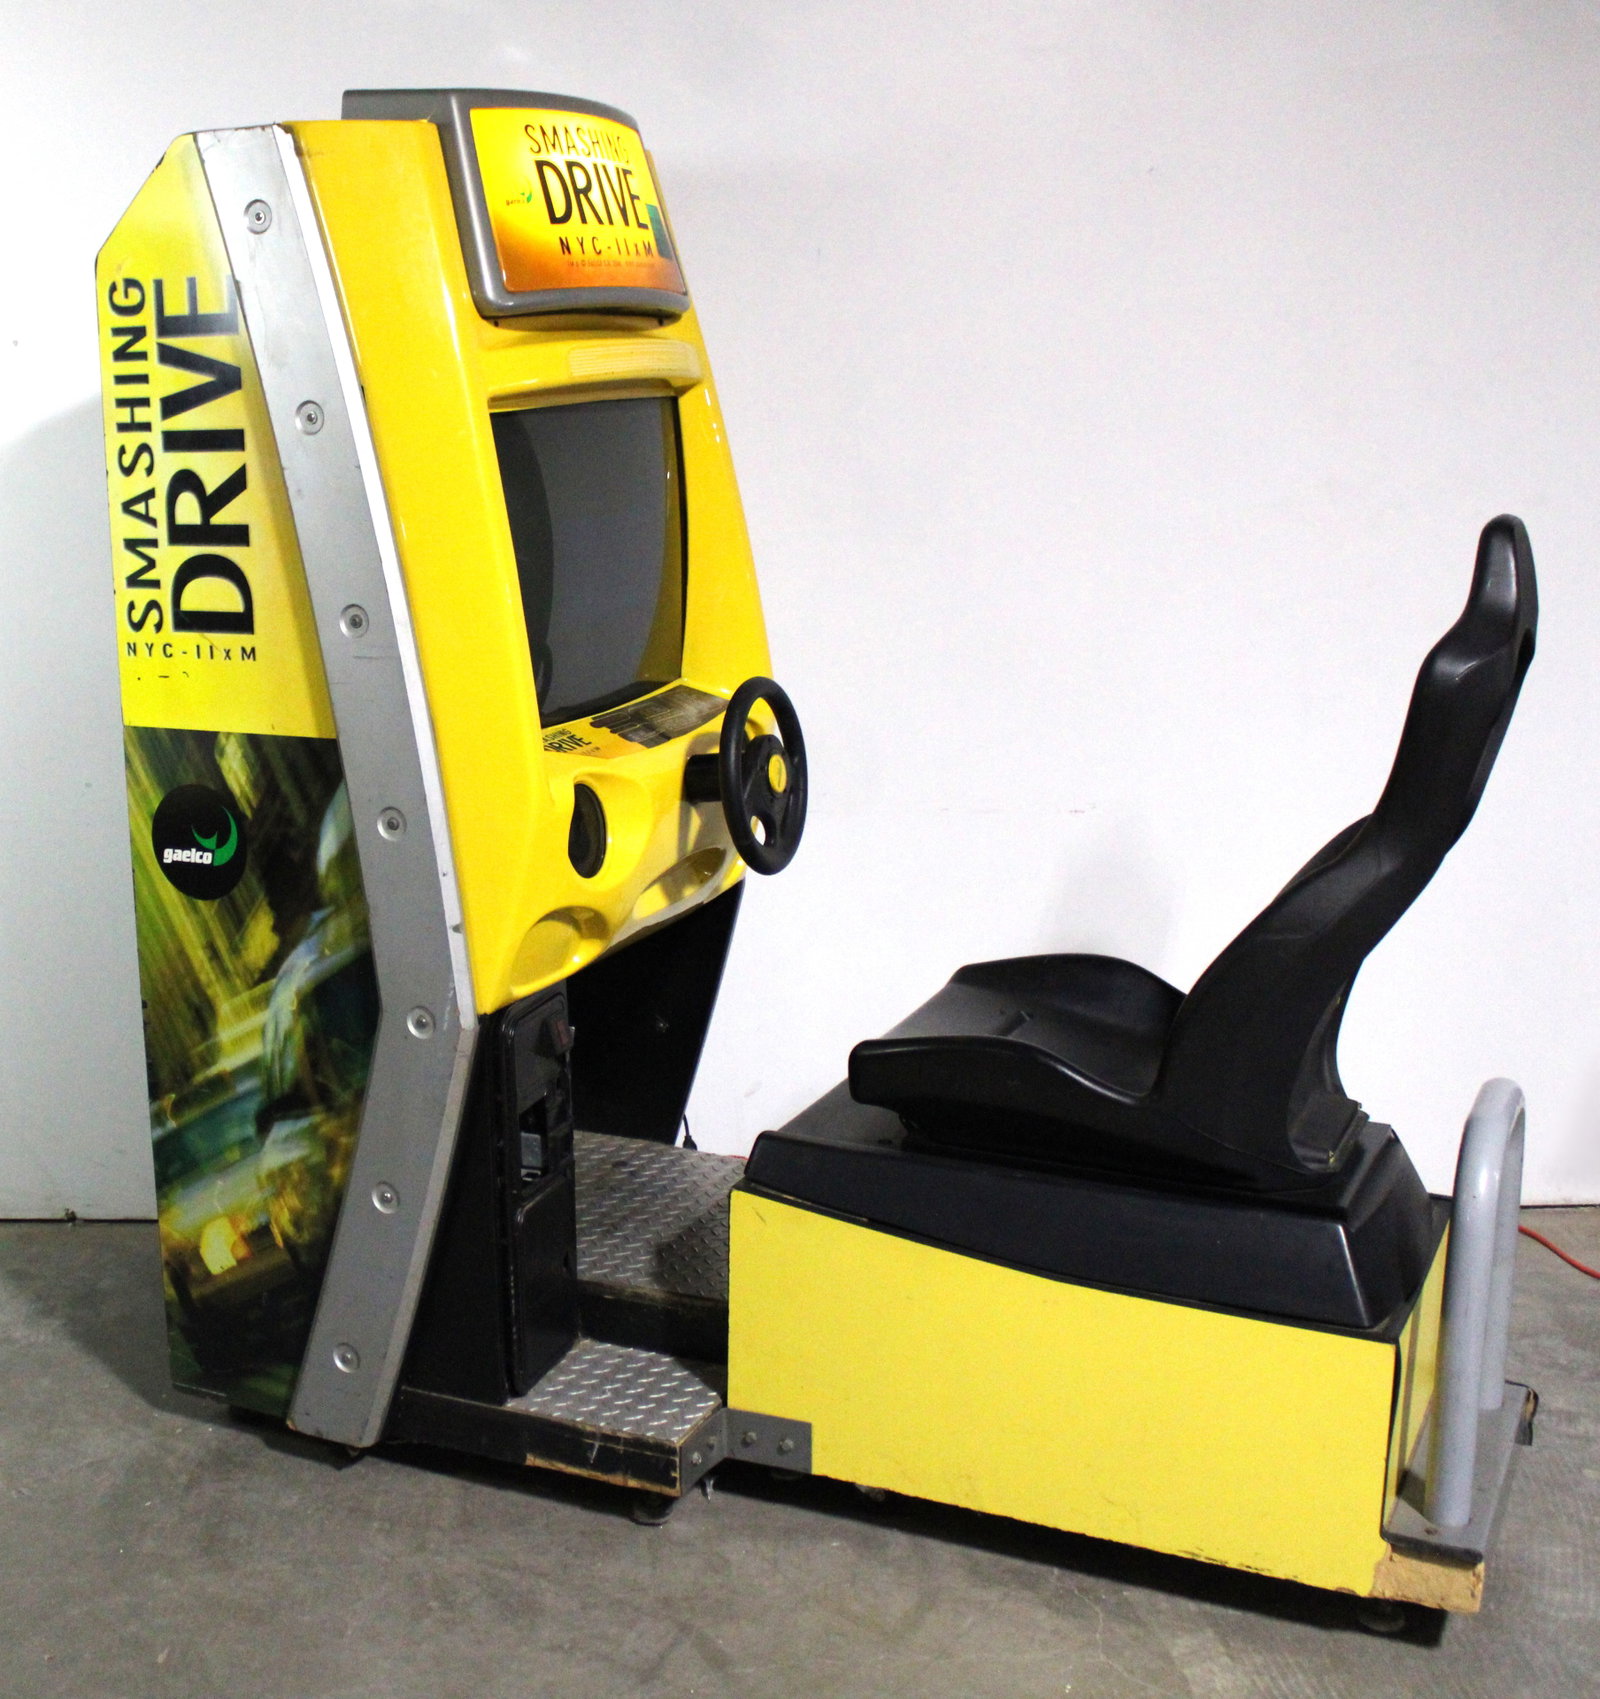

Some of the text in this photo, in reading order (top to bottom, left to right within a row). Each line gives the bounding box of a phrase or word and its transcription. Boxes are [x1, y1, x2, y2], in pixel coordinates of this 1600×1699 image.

[525, 123, 630, 164] SMASHING
[534, 160, 650, 231] DRIVE
[108, 276, 163, 635] SMASHING
[156, 274, 256, 636] DRIVE
[163, 848, 213, 864] gaelco
